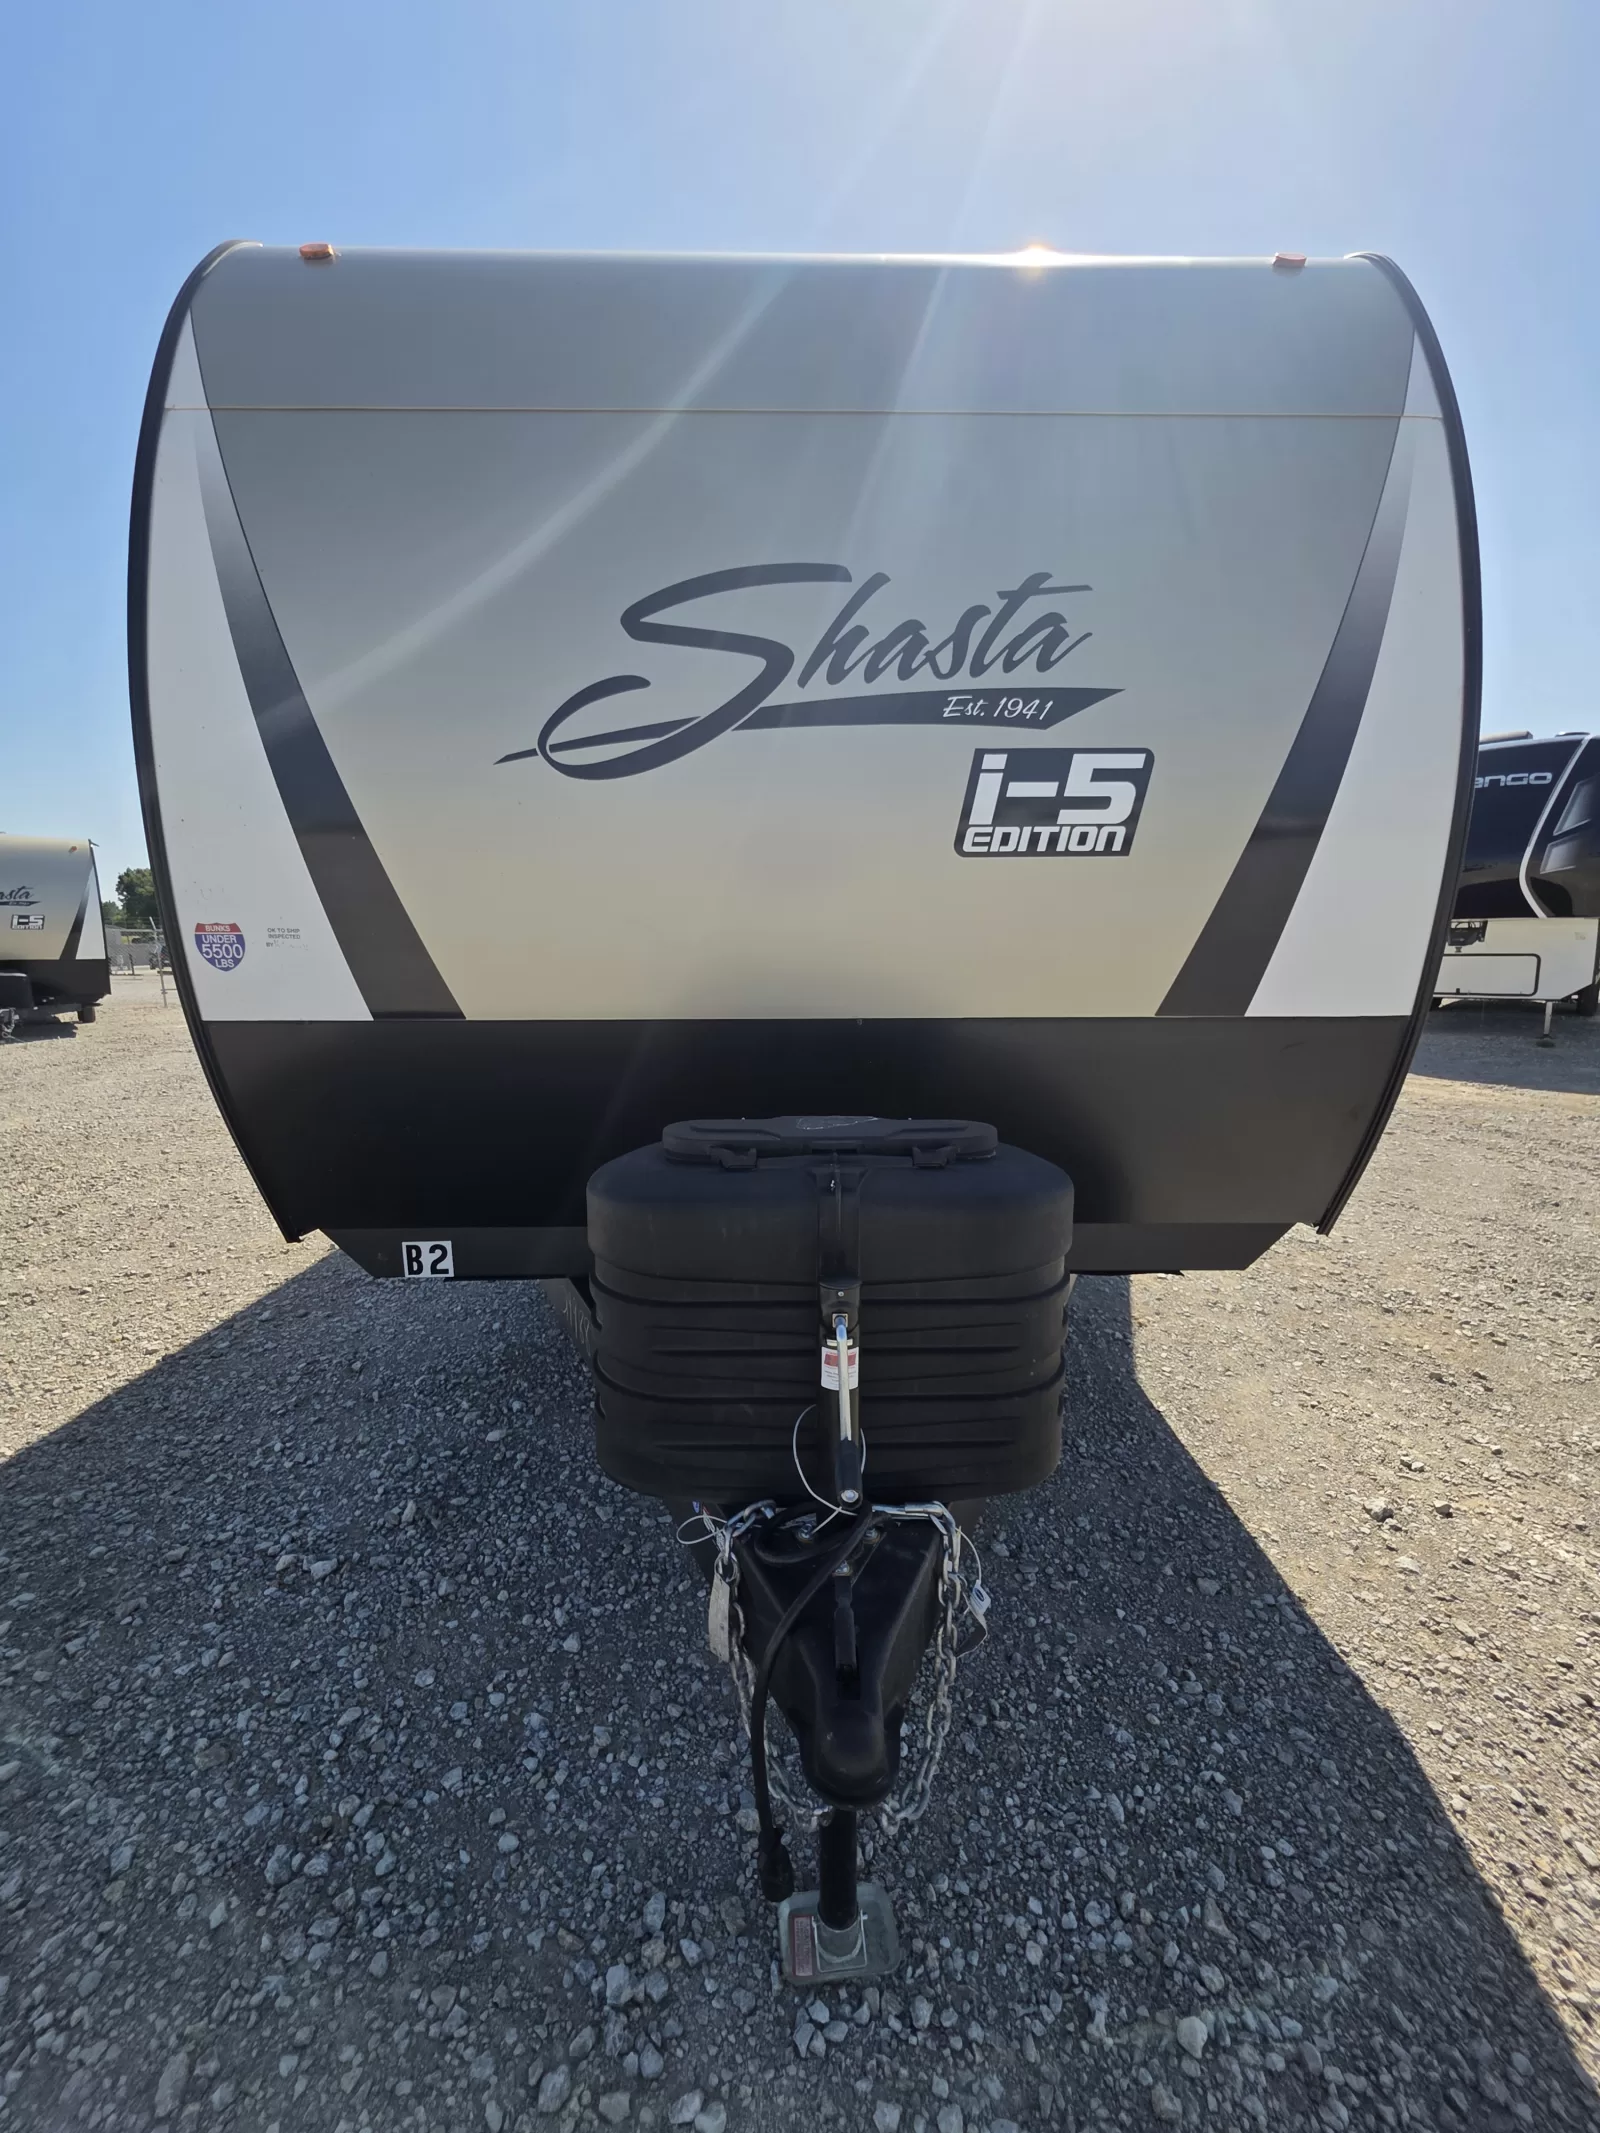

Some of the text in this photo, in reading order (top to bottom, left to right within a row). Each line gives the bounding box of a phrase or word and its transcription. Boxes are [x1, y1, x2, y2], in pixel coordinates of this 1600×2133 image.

[537, 563, 1093, 780] Shasta
[942, 695, 1053, 720] Est. 1941
[968, 753, 1146, 825] i-5
[962, 826, 1127, 852] EDITION
[202, 934, 237, 943] UNDER
[202, 944, 243, 959] 5500
[215, 959, 235, 968] LBS
[405, 1244, 450, 1275] B2
